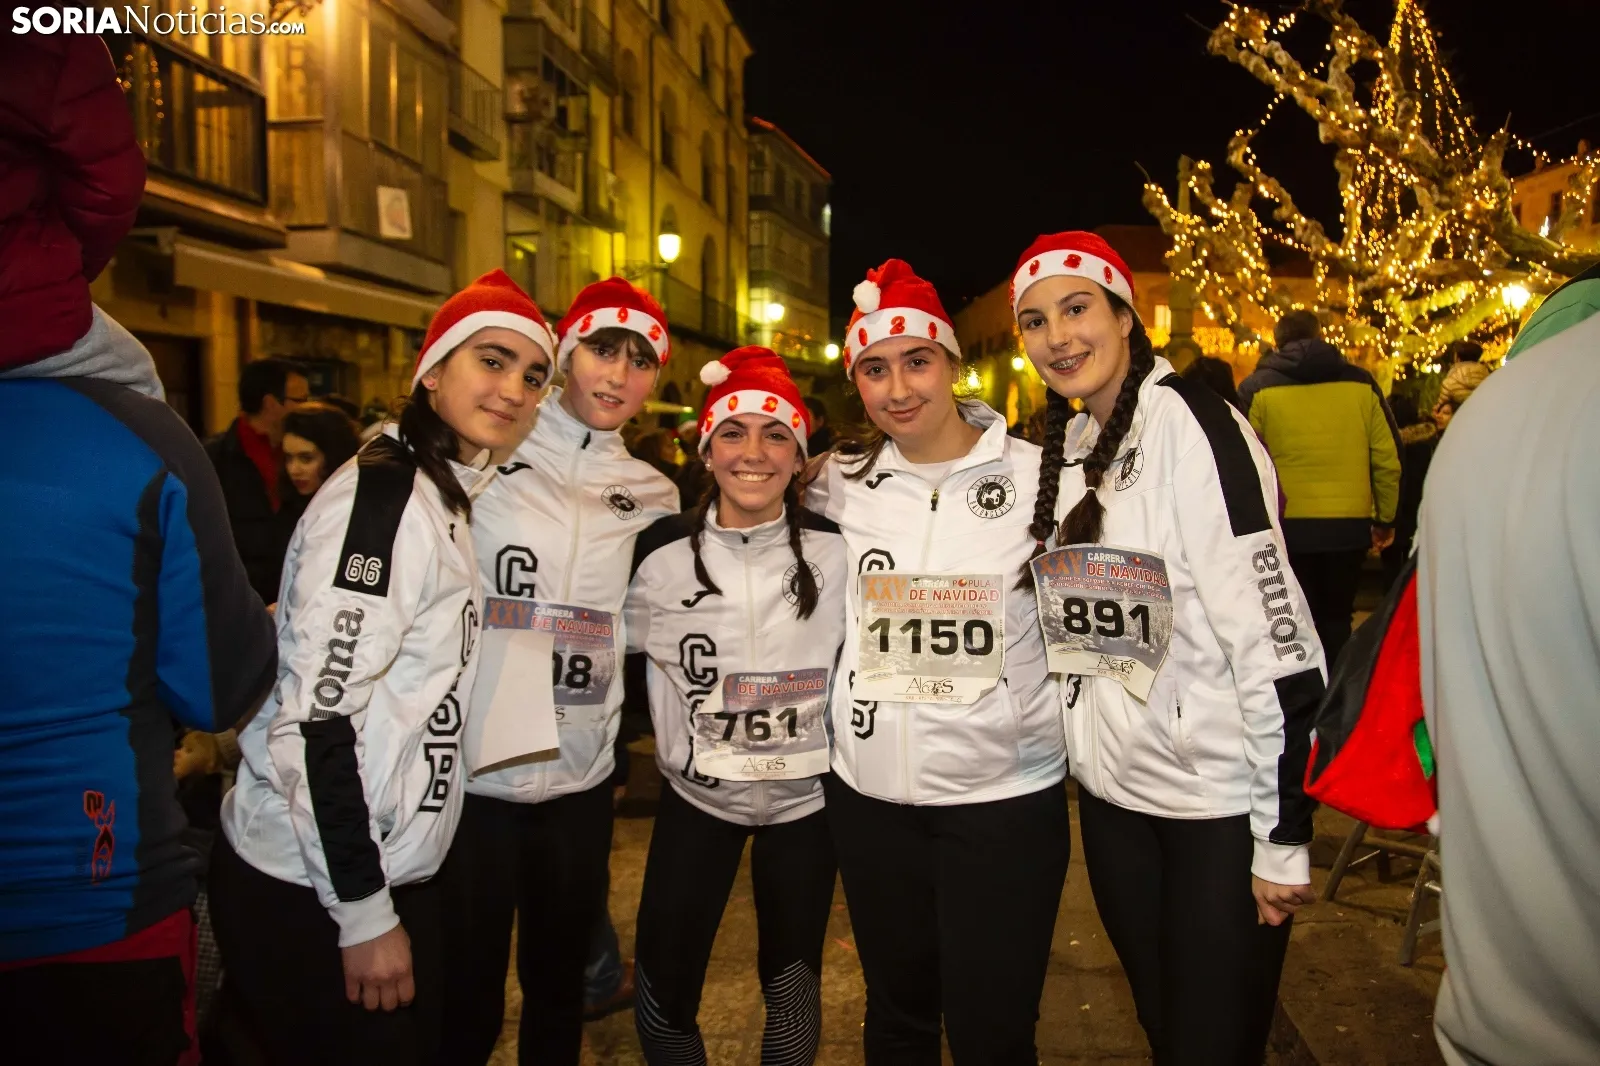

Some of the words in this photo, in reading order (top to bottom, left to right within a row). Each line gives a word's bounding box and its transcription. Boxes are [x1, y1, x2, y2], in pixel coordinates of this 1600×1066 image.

[345, 553, 382, 587] 66
[1037, 552, 1082, 576] XXV
[1088, 552, 1126, 564] CARRERA
[1086, 562, 1106, 577] DE
[1110, 564, 1168, 588] NAVIDAD
[864, 576, 908, 600] XXV
[909, 589, 928, 601] DE
[932, 589, 1000, 602] NAVIDAD
[487, 600, 530, 627] XXV
[534, 606, 574, 619] CARRERA
[530, 615, 552, 631] DE
[555, 619, 612, 637] NAVIDAD
[1063, 597, 1150, 645] 891
[867, 617, 994, 656] 1150
[737, 683, 757, 695] DE
[761, 679, 825, 696] NAVIDAD
[738, 675, 778, 684] CARRERA
[713, 707, 798, 742] 761
